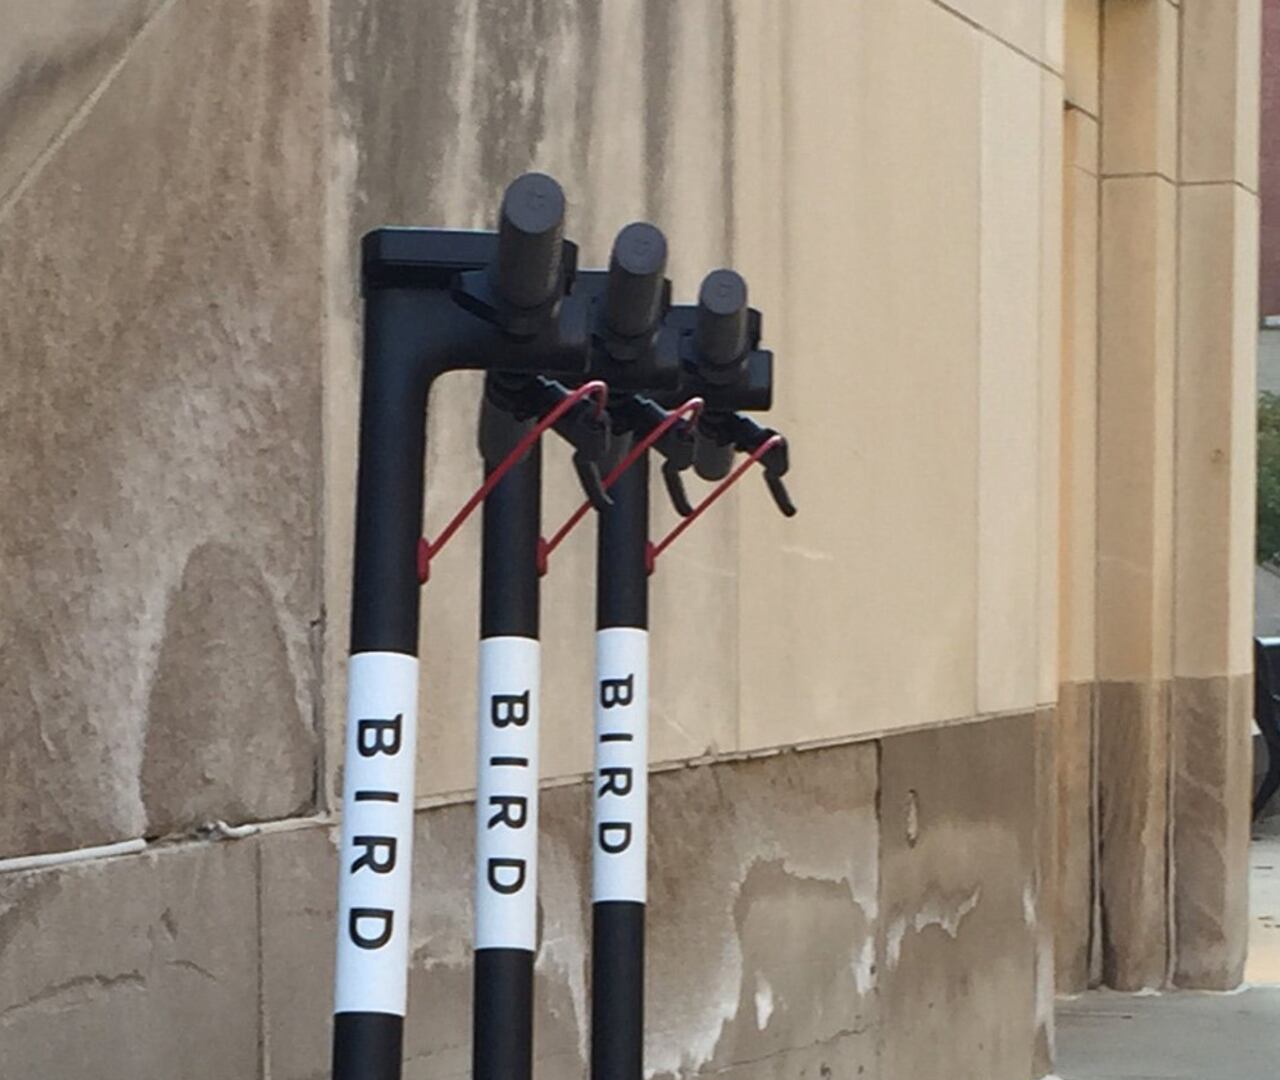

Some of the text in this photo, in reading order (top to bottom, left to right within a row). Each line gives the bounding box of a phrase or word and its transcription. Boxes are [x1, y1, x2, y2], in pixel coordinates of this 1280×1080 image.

[349, 714, 402, 951] BIRD
[487, 690, 530, 895] BIRD
[598, 674, 634, 854] BIRD
